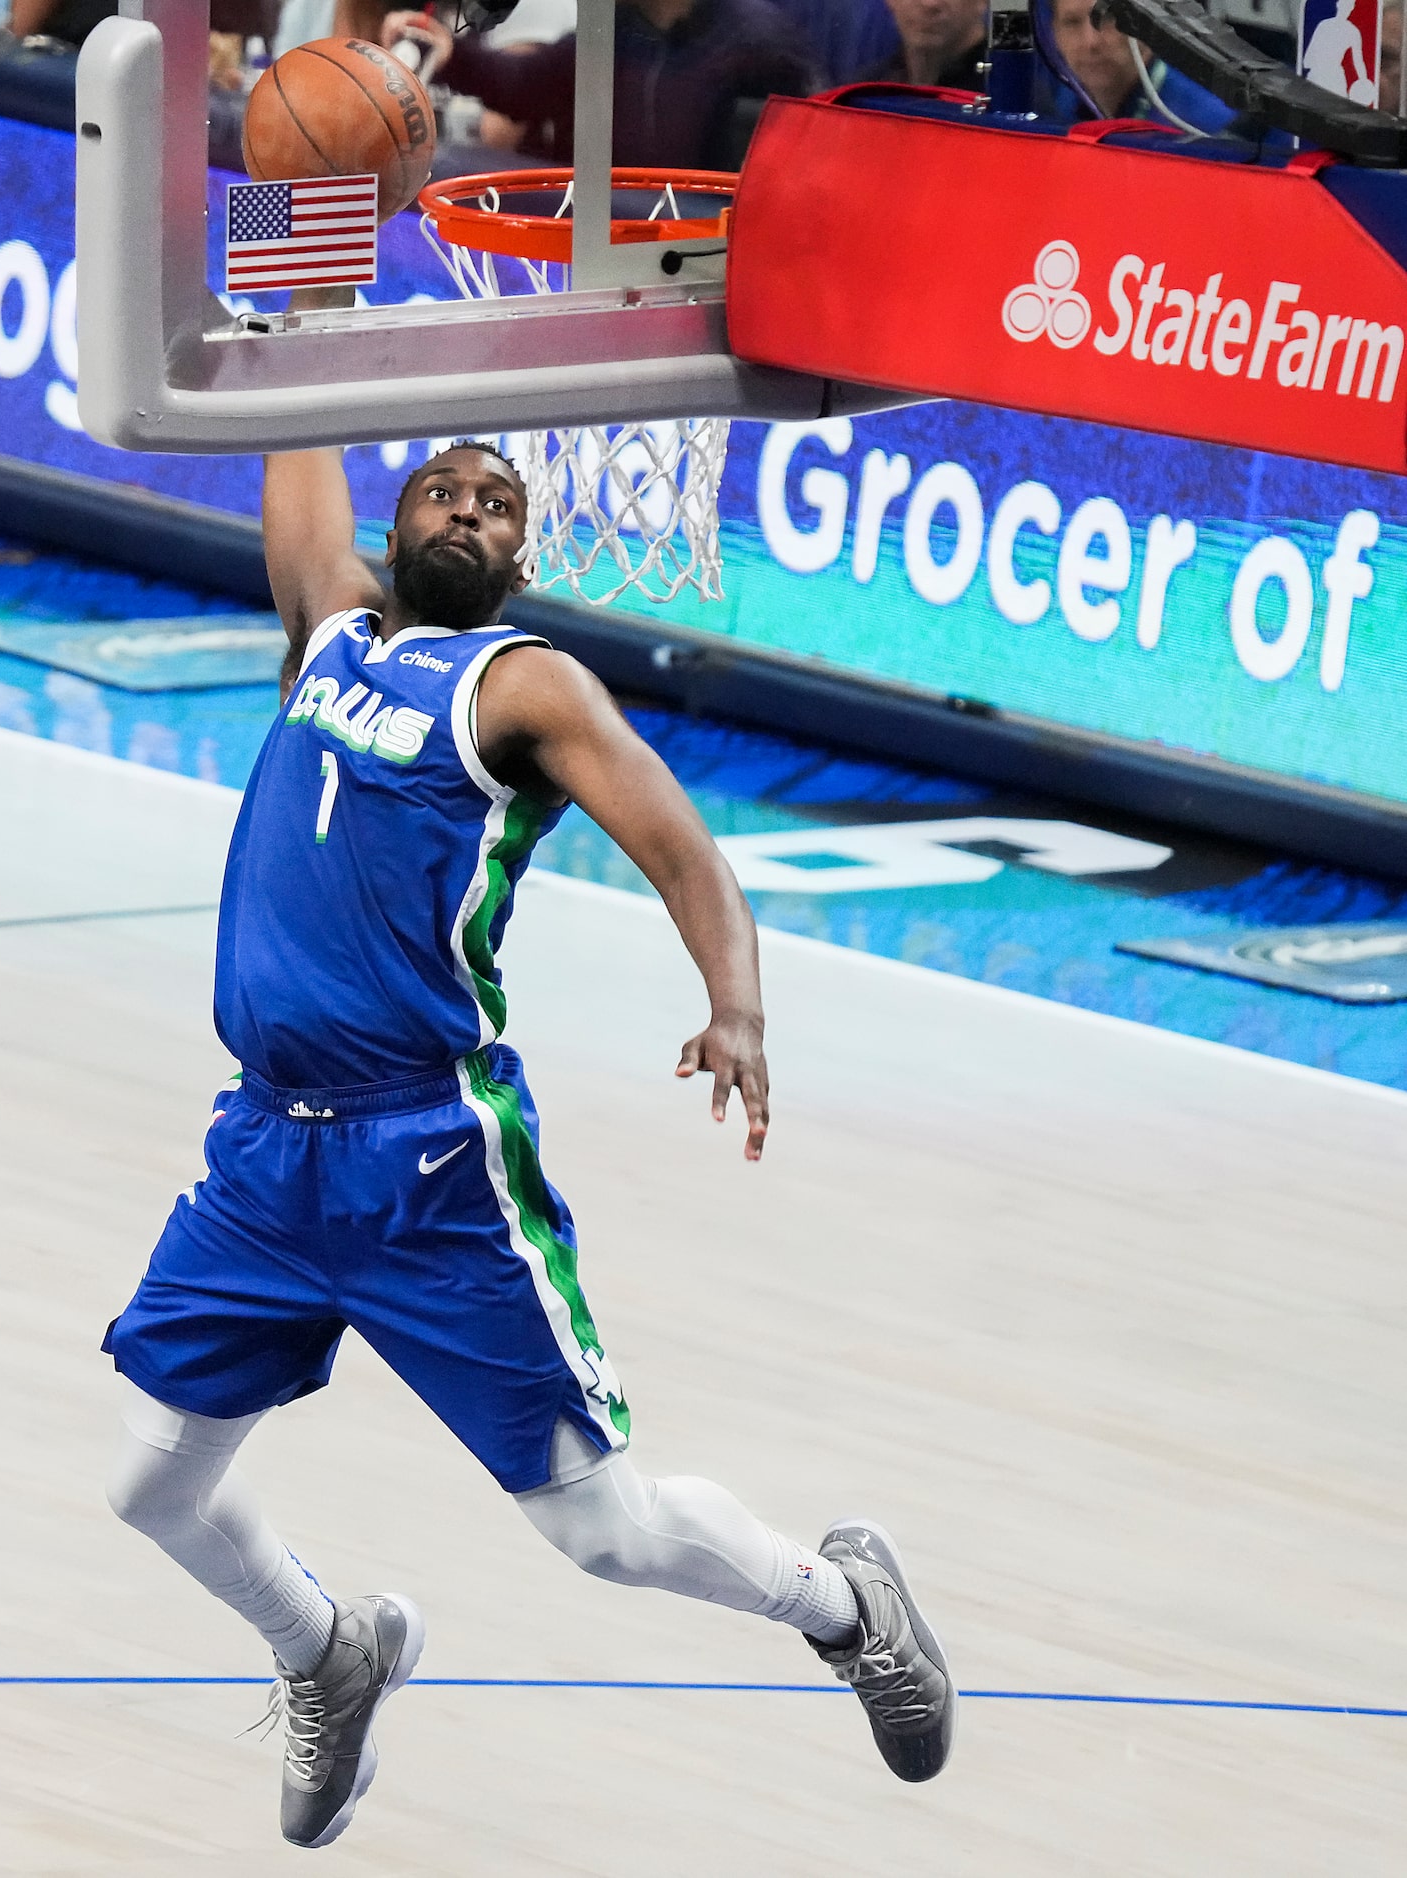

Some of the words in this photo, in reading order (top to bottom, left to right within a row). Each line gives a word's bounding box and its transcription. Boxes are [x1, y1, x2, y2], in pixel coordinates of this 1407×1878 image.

[757, 416, 1197, 650] Grocer
[1228, 507, 1380, 691] of
[398, 649, 454, 674] chime
[314, 750, 340, 844] 1
